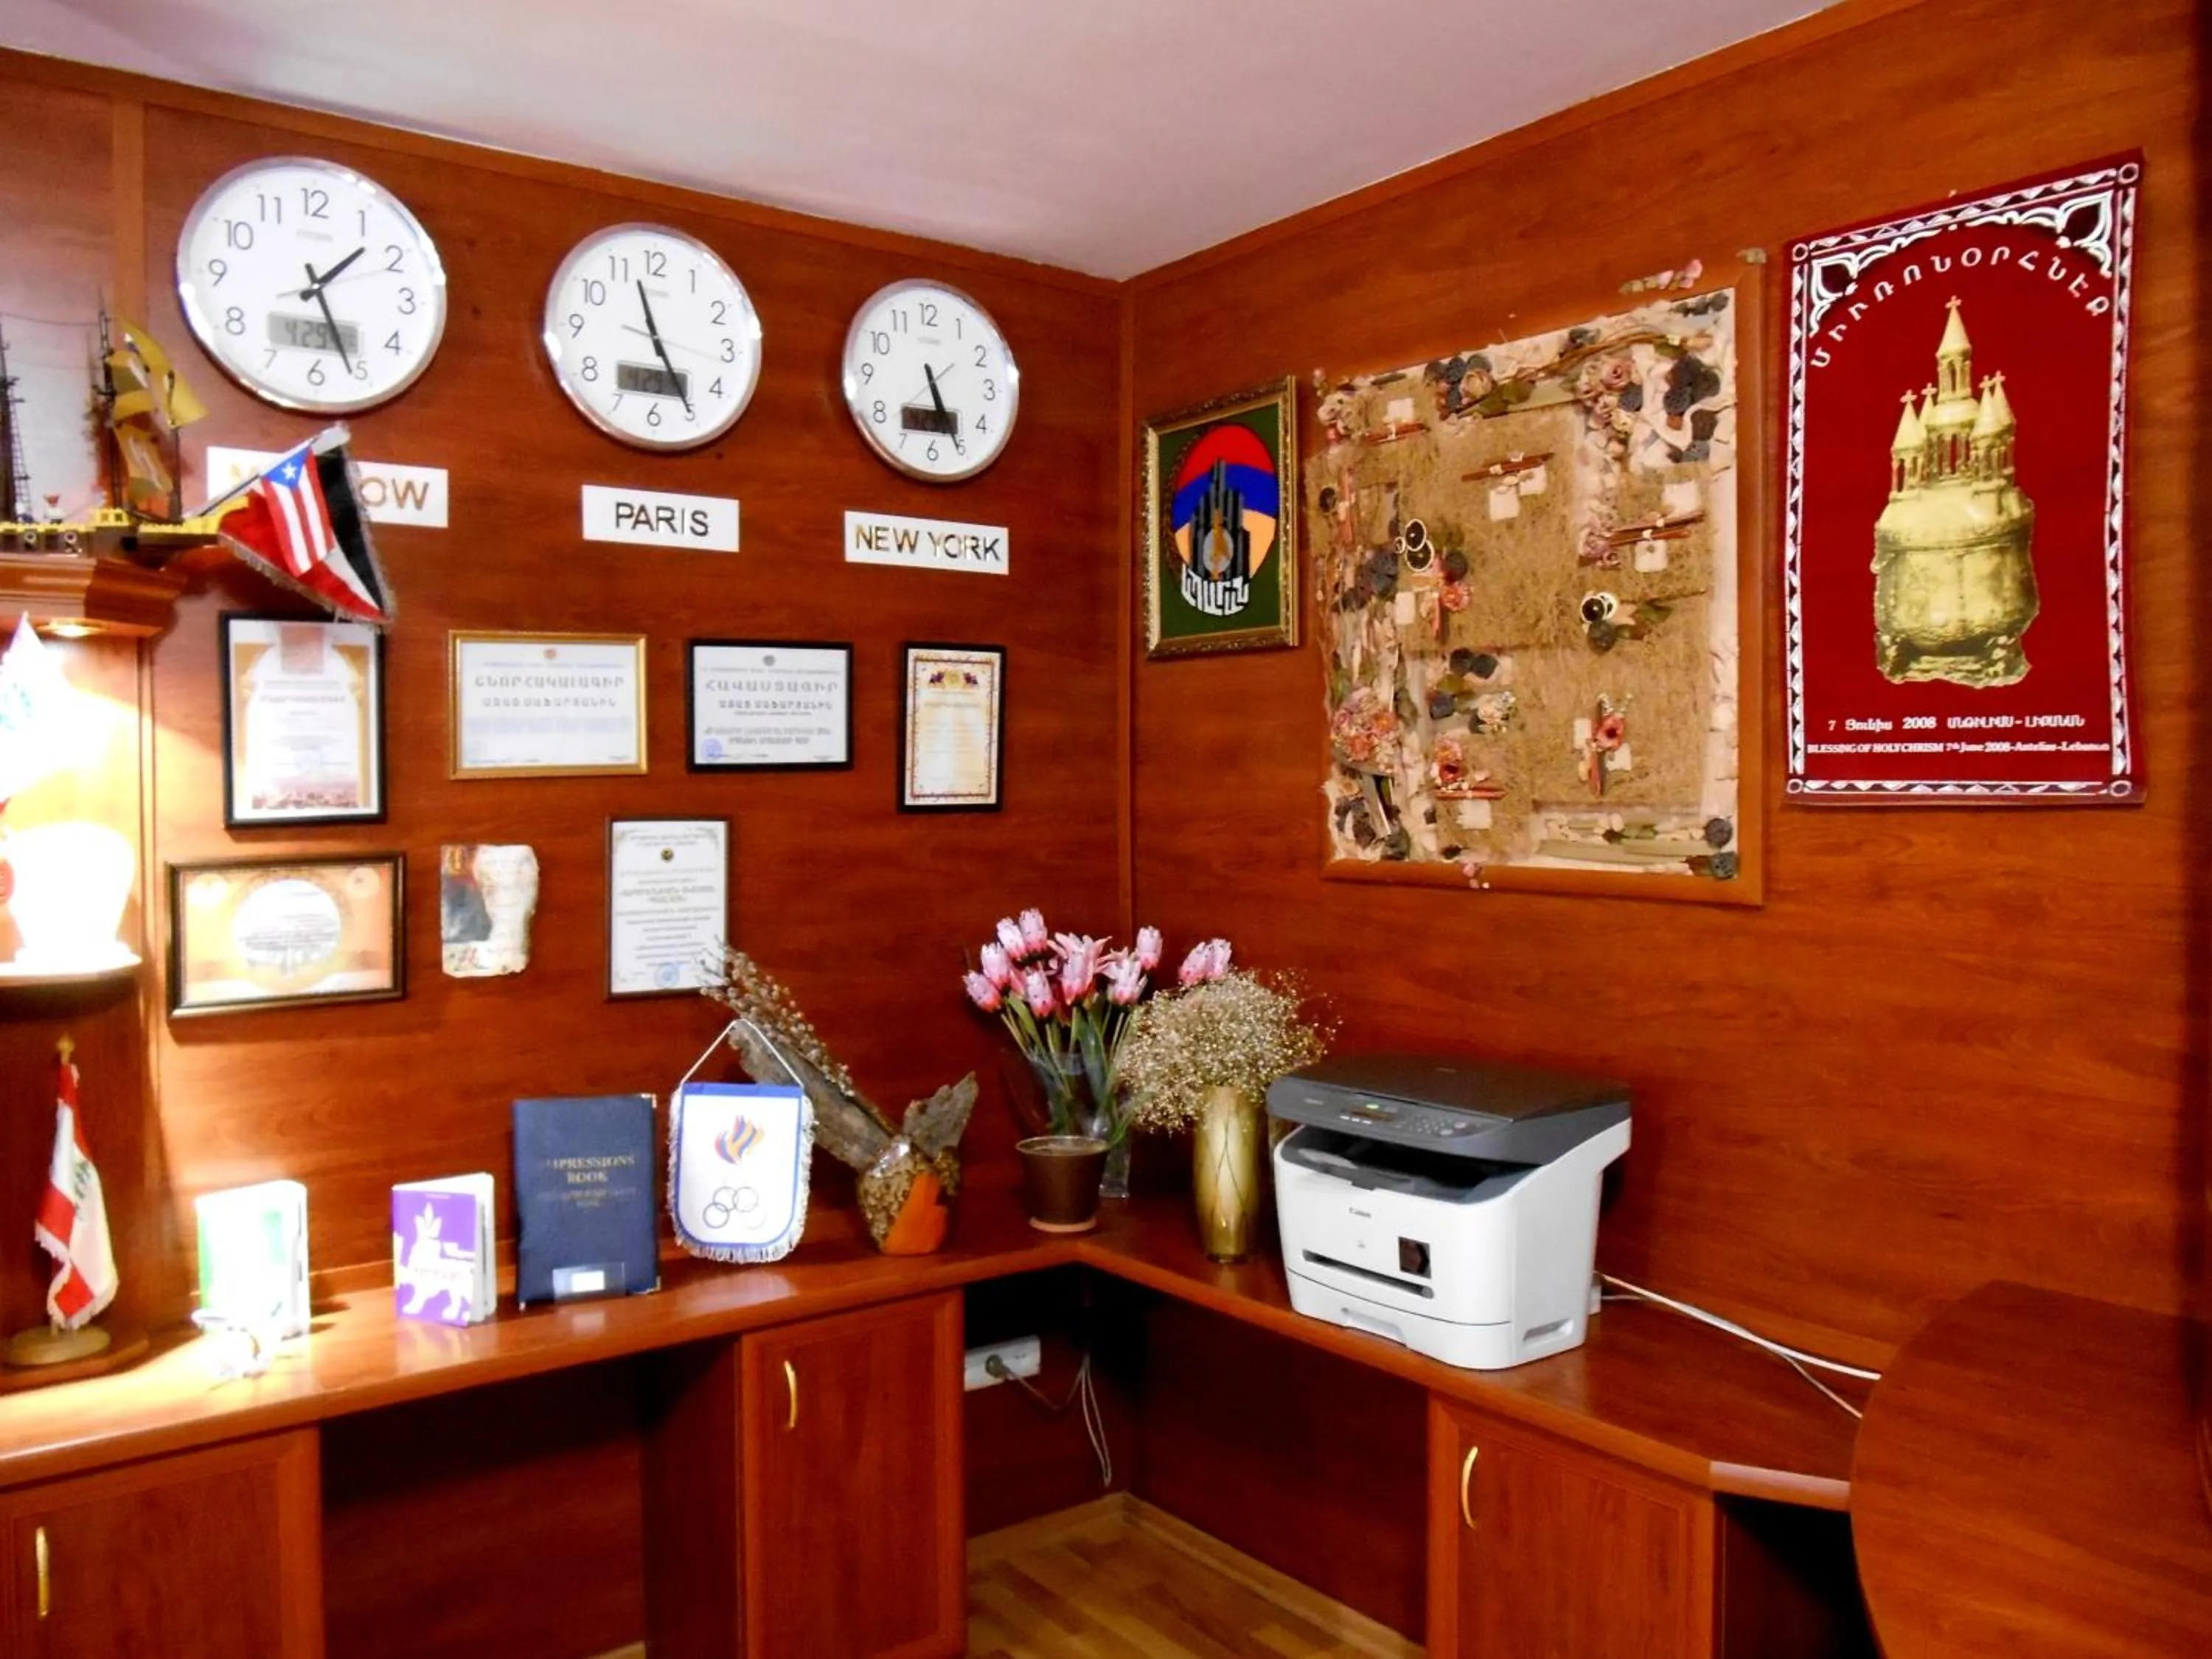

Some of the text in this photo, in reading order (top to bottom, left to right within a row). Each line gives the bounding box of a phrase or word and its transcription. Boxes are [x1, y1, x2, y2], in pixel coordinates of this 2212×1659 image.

[257, 194, 282, 225] 11
[301, 187, 329, 219] 12
[223, 219, 254, 251] 10
[358, 210, 366, 237] 1
[385, 245, 404, 273] 2
[609, 256, 628, 283] 11
[644, 250, 667, 277] 12
[208, 259, 227, 287] 9
[689, 269, 696, 293] 1
[397, 288, 416, 315] 3
[582, 279, 606, 306] 10
[225, 306, 246, 335] 8
[711, 300, 726, 325] 2
[891, 309, 908, 333] 11
[919, 303, 939, 327] 12
[568, 313, 585, 338] 9
[956, 318, 961, 341] 1
[384, 331, 402, 356] 4
[720, 338, 735, 363] 3
[871, 331, 890, 355] 10
[263, 349, 277, 369] 7
[975, 345, 987, 368] 2
[307, 359, 325, 386] 6
[354, 361, 368, 380] 5
[582, 356, 598, 382] 8
[861, 363, 874, 386] 9
[709, 377, 723, 398] 4
[984, 379, 995, 400] 3
[613, 393, 624, 411] 7
[873, 400, 886, 424] 8
[647, 402, 661, 427] 6
[976, 414, 987, 434] 4
[899, 433, 908, 449] 7
[927, 439, 939, 461] 6
[958, 439, 966, 456] 5
[616, 501, 709, 538] PARIS
[855, 524, 1001, 562] NEW YORK
[1902, 717, 1937, 729] 2008
[1807, 743, 1856, 754] BLESSING
[1857, 743, 1872, 753] OF
[1872, 743, 1901, 753] HOLY
[539, 1155, 636, 1169] MPRESSIONS
